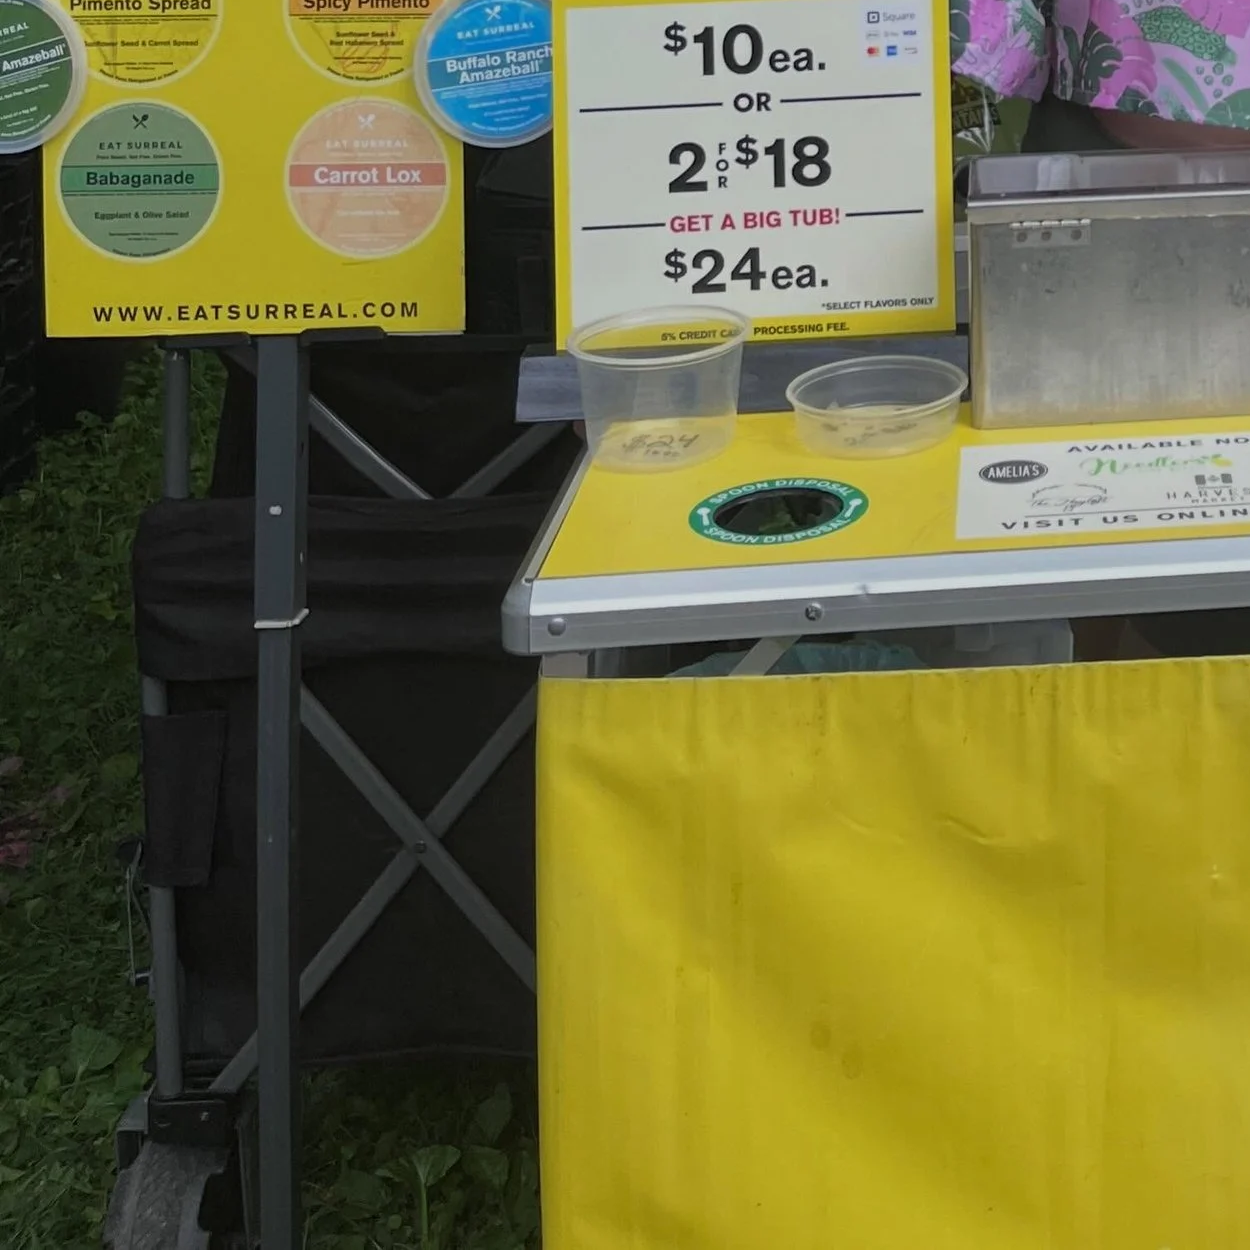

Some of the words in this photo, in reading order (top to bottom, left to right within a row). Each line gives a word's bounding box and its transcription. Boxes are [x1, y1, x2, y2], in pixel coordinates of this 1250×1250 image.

[882, 11, 917, 22] Square
[2, 44, 64, 72] Amazeball
[663, 20, 764, 77] $10
[769, 46, 827, 73] ea.
[459, 61, 540, 85] Amazeball
[733, 93, 772, 113] OR
[668, 141, 709, 193] 2
[717, 142, 730, 189] FOR
[734, 134, 832, 189] $18
[86, 170, 195, 189] Babaganade
[313, 166, 379, 184] Carrot
[386, 166, 422, 183] Lox
[670, 213, 714, 233] GET
[721, 213, 739, 232] A
[743, 210, 783, 231] BIG
[790, 208, 840, 228] TUB!
[663, 246, 767, 295] $24
[771, 262, 829, 290] ea.
[93, 301, 420, 323] WWW.EATSURREAL.COM
[864, 298, 908, 309] FLAVORS
[910, 296, 935, 307] ONLY
[753, 323, 824, 336] PROCESSING
[826, 321, 850, 332] FEE.
[1067, 439, 1203, 453] AVAILABLE
[986, 463, 1041, 480] AMELIA'S
[709, 479, 770, 506] SPOON
[774, 477, 853, 497] DISPOSAL
[703, 525, 761, 545] SPOON
[763, 517, 853, 545] DISPOSAL
[1001, 516, 1084, 530] VISIT
[1102, 514, 1140, 525] US
